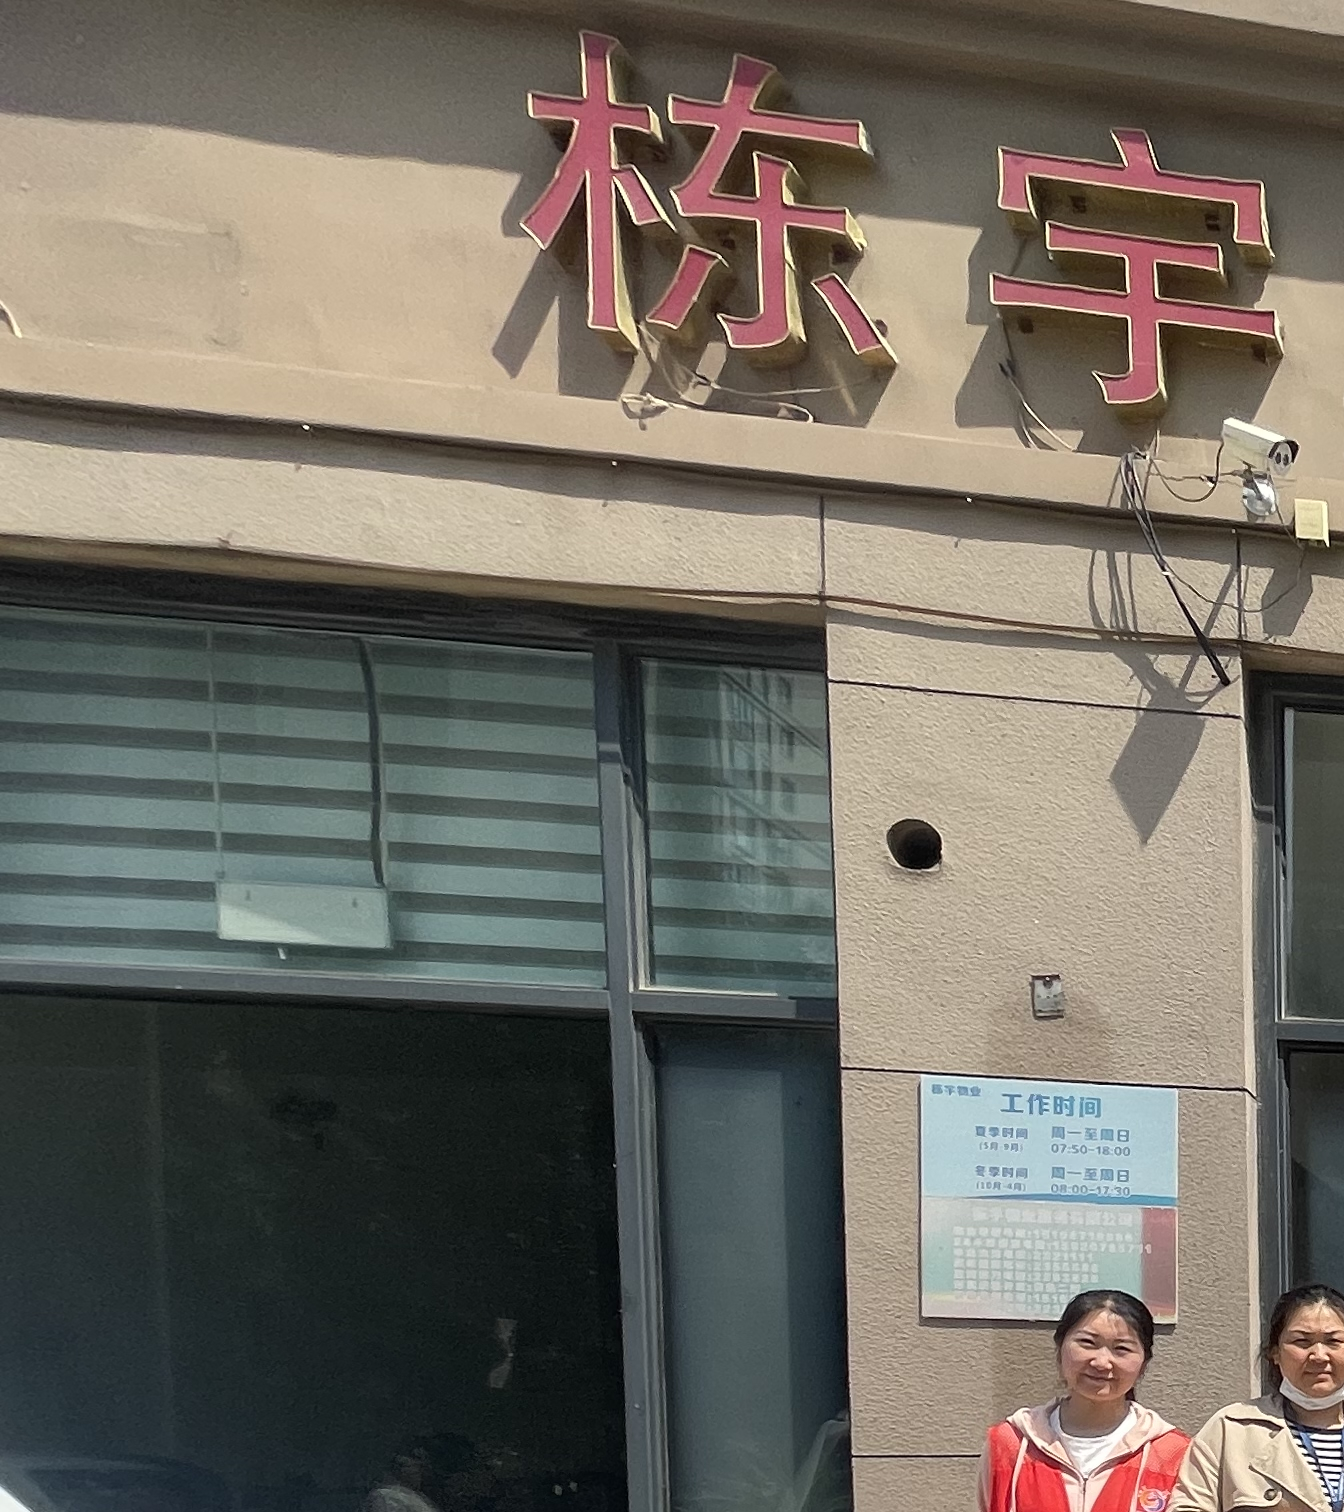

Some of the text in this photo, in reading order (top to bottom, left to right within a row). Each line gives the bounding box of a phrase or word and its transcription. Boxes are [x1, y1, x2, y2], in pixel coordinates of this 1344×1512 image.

[1000, 1093, 1102, 1118] 工作时间
[1051, 1126, 1130, 1143] 周一至周日
[1051, 1143, 1131, 1157] 07:50-18:00
[1051, 1166, 1130, 1182] 周一至周日
[1051, 1184, 1131, 1197] 08:00-17:30
